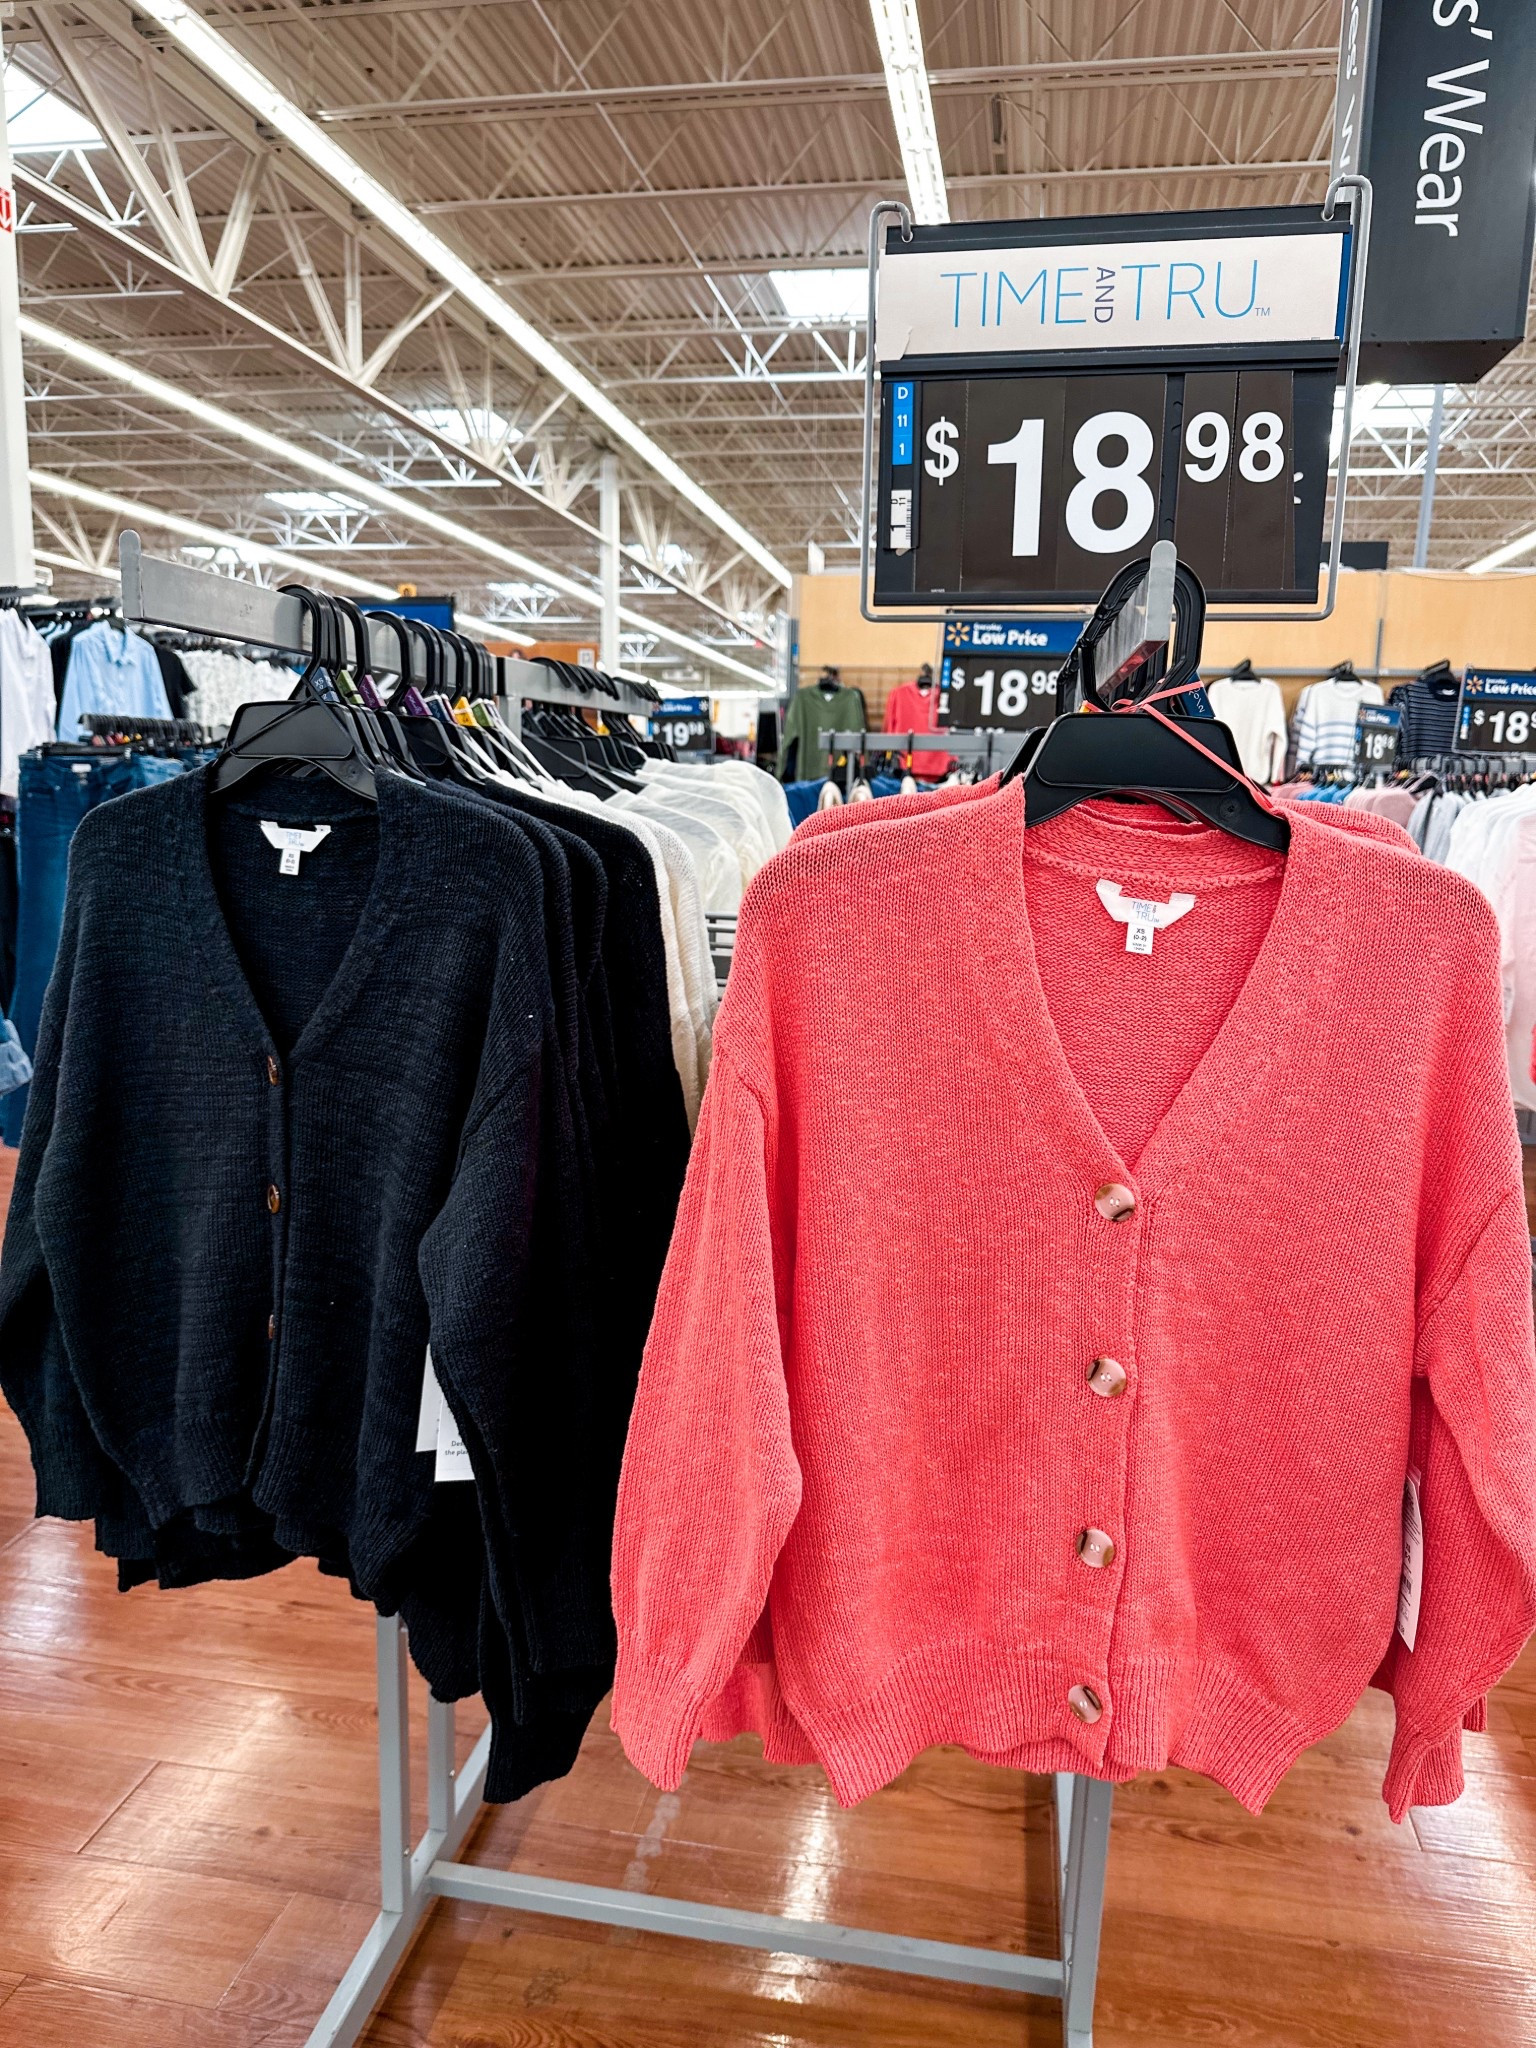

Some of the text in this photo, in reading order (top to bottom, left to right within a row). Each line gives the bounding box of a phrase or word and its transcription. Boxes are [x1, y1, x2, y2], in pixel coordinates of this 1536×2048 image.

[1414, 59, 1490, 237] Wear
[940, 267, 1090, 328] TIME
[1094, 266, 1115, 324] AND
[1121, 259, 1258, 321] TRU
[897, 386, 909, 400] D
[896, 413, 908, 428] 11
[899, 442, 905, 456] 1
[972, 629, 1048, 646] Low Price
[1484, 678, 1510, 694] Low
